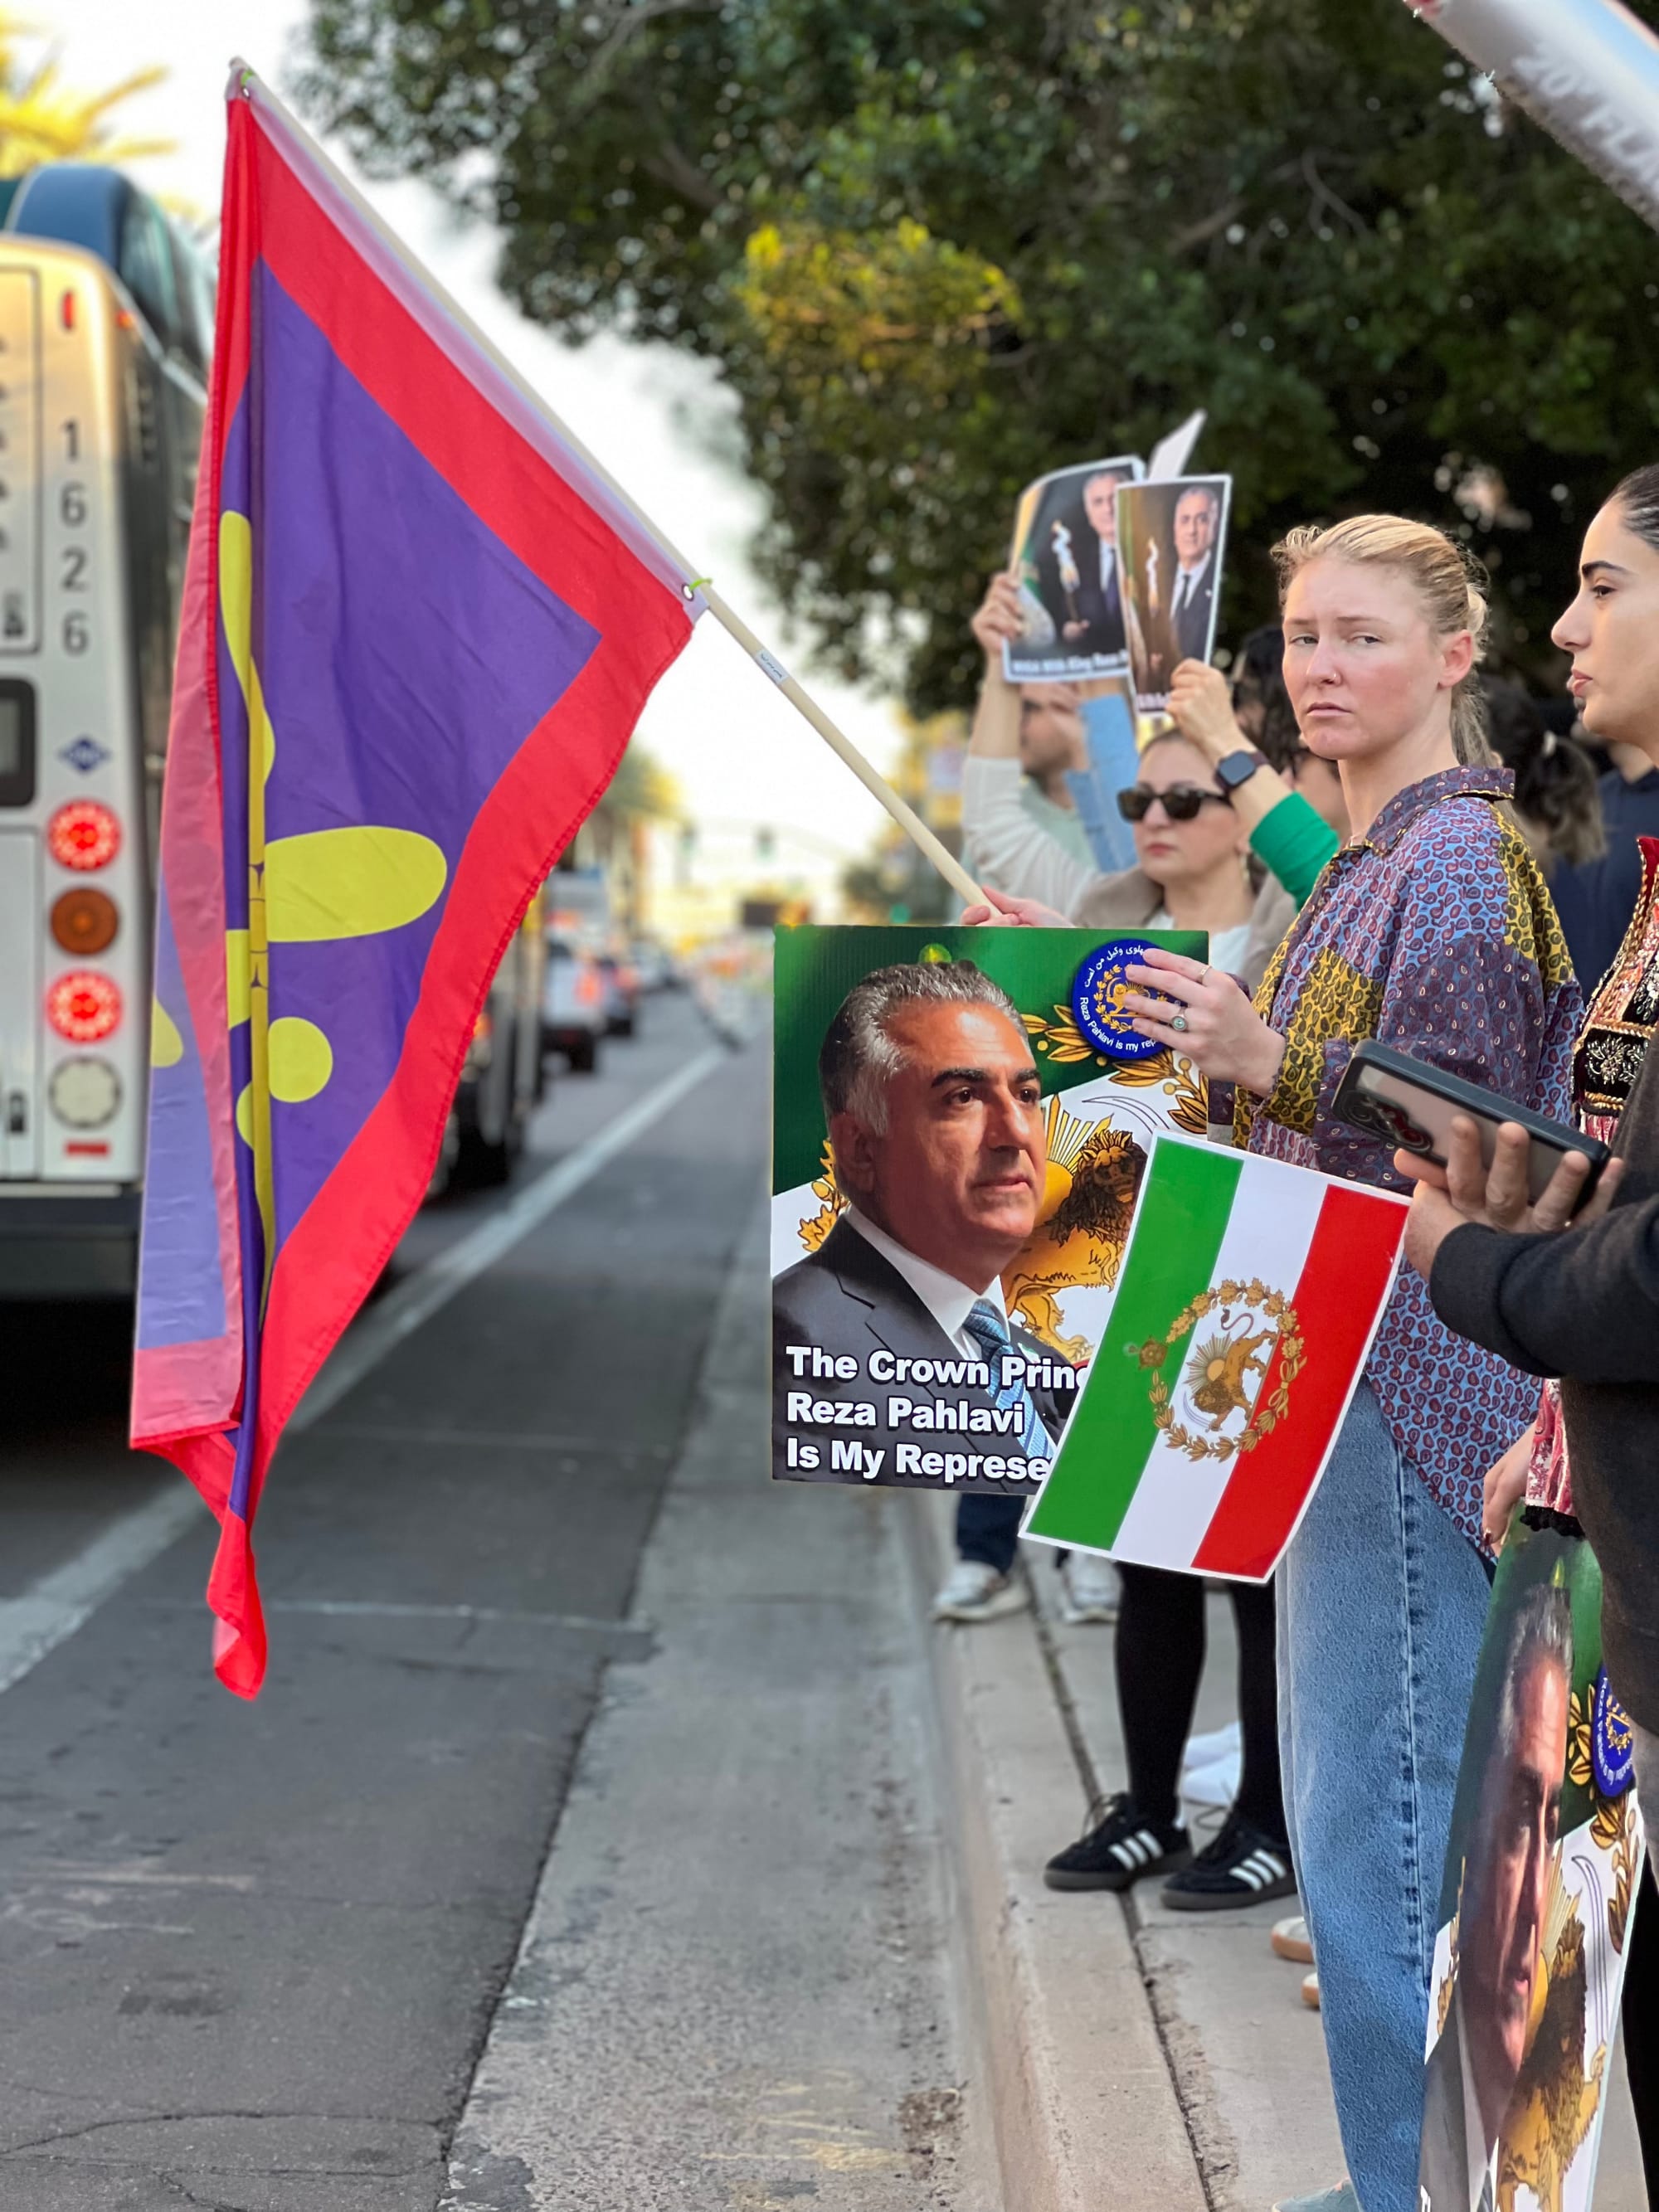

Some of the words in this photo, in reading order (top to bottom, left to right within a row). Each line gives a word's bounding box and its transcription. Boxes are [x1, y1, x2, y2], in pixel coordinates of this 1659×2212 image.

[61, 419, 90, 658] 1626
[1096, 958, 1105, 970] من
[1126, 945, 1145, 956] هلوی
[1080, 997, 1091, 1021] Reza
[1088, 1020, 1114, 1046] Pahlavi
[1116, 1039, 1123, 1049] is
[1126, 1042, 1139, 1053] my
[786, 1345, 859, 1380] The
[869, 1349, 990, 1386] Crown
[787, 1392, 877, 1426] Reza
[888, 1396, 1024, 1433] Pahlavi
[787, 1437, 820, 1469] Is
[831, 1439, 886, 1479] My
[896, 1443, 1053, 1483] Represe
